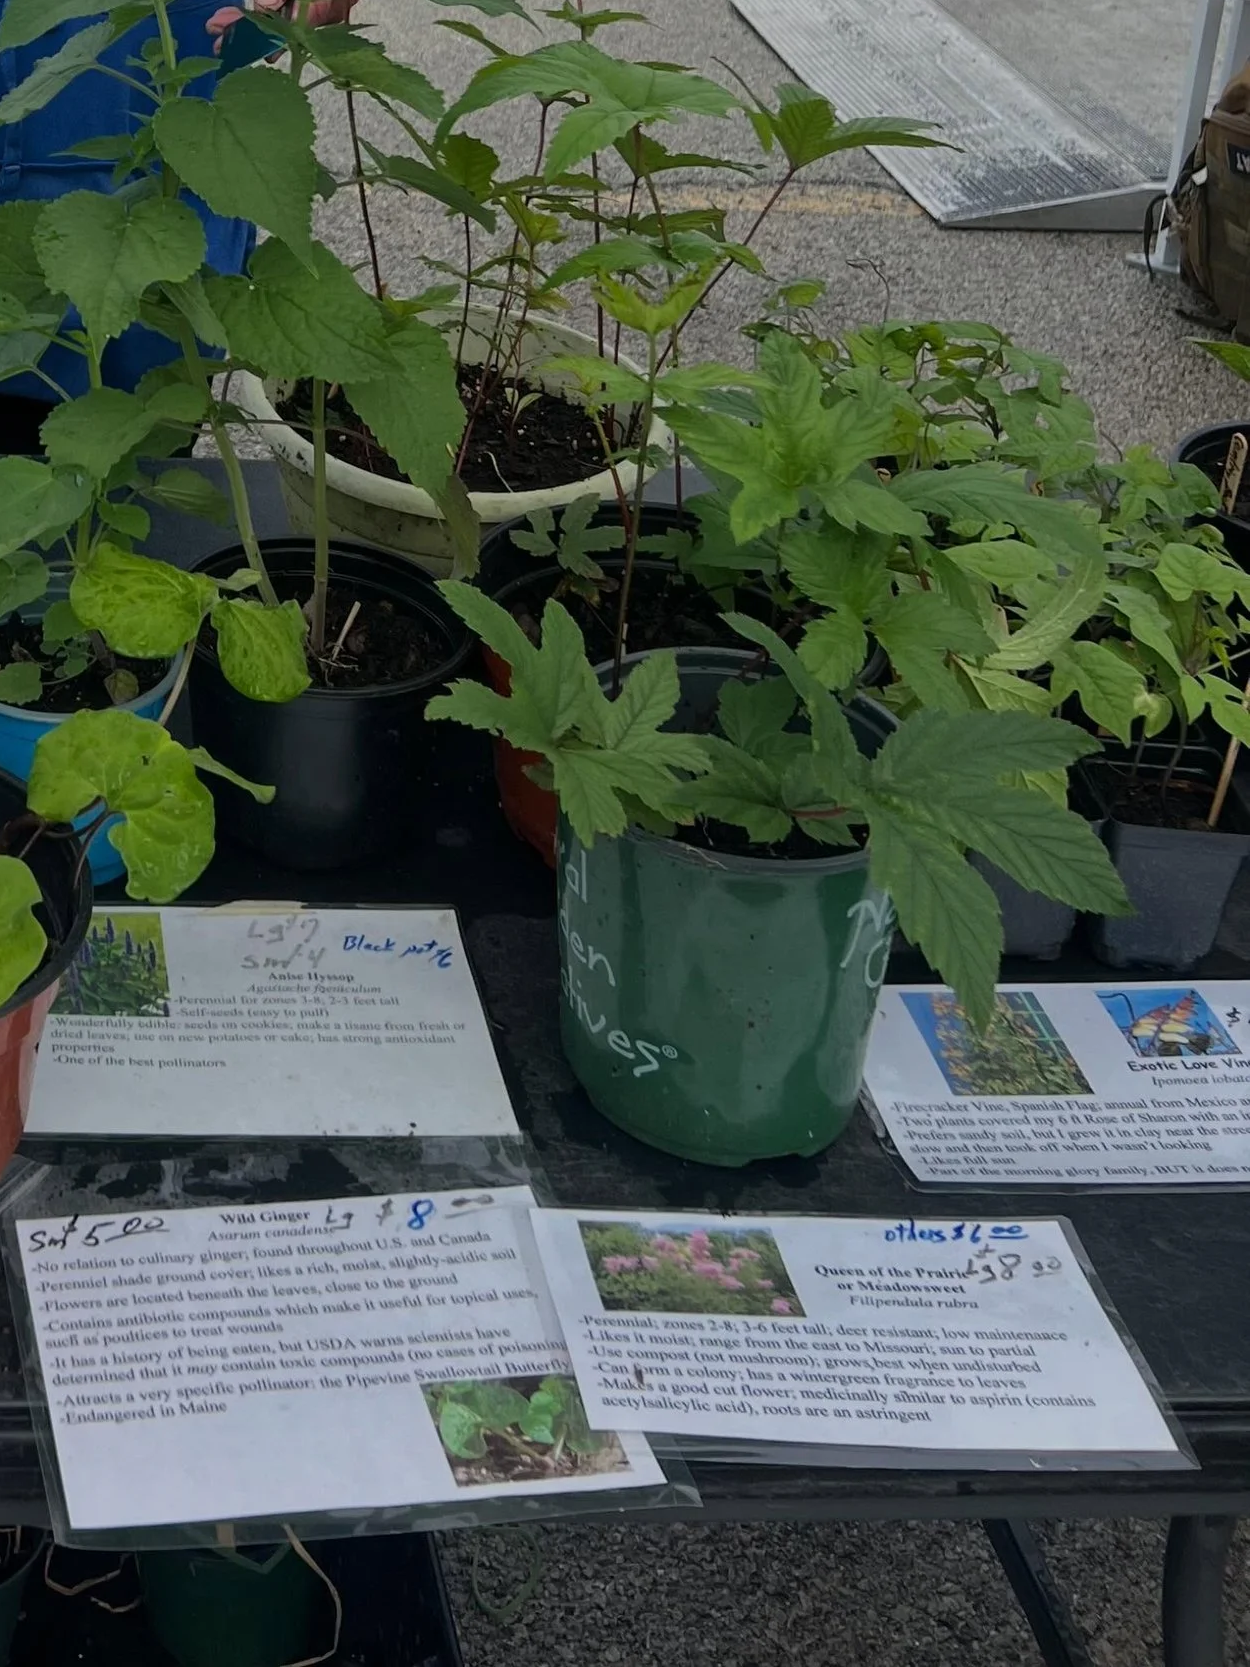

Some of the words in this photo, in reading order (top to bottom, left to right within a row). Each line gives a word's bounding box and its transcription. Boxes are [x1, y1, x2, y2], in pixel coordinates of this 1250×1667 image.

[343, 935, 397, 952] Black
[219, 1212, 256, 1225] Wild
[258, 1210, 309, 1223] Ginger
[209, 1230, 261, 1241] Asarum
[884, 1218, 947, 1243] others
[62, 1257, 117, 1270] relation
[119, 1257, 135, 1267] to
[137, 1251, 194, 1265] culinary
[252, 1244, 293, 1258] found
[295, 1240, 373, 1256] throughout
[409, 1234, 436, 1247] and
[437, 1230, 491, 1246] Canada
[813, 1264, 866, 1278] Queen
[867, 1265, 884, 1278] of
[886, 1266, 912, 1278] the
[836, 1282, 853, 1291] or
[856, 1280, 966, 1294] Meadowsweet
[936, 1297, 979, 1309] rubra
[44, 1333, 79, 1349] such
[82, 1332, 99, 1346] as
[102, 1329, 169, 1347] poultices
[171, 1327, 187, 1338] to
[189, 1325, 224, 1337] treat
[226, 1320, 284, 1334] wounds
[632, 1332, 646, 1344] it
[698, 1337, 741, 1349] range
[743, 1336, 782, 1349] from
[783, 1337, 809, 1350] the
[810, 1341, 842, 1351] east
[843, 1341, 861, 1352] to
[938, 1345, 967, 1355] sun
[967, 1345, 985, 1356] to
[986, 1345, 1037, 1358] partial
[159, 1403, 175, 1418] in
[178, 1400, 227, 1415] Maine
[761, 1404, 802, 1416] roots
[803, 1406, 829, 1417] are
[831, 1407, 853, 1418] an
[854, 1407, 932, 1423] astringent
